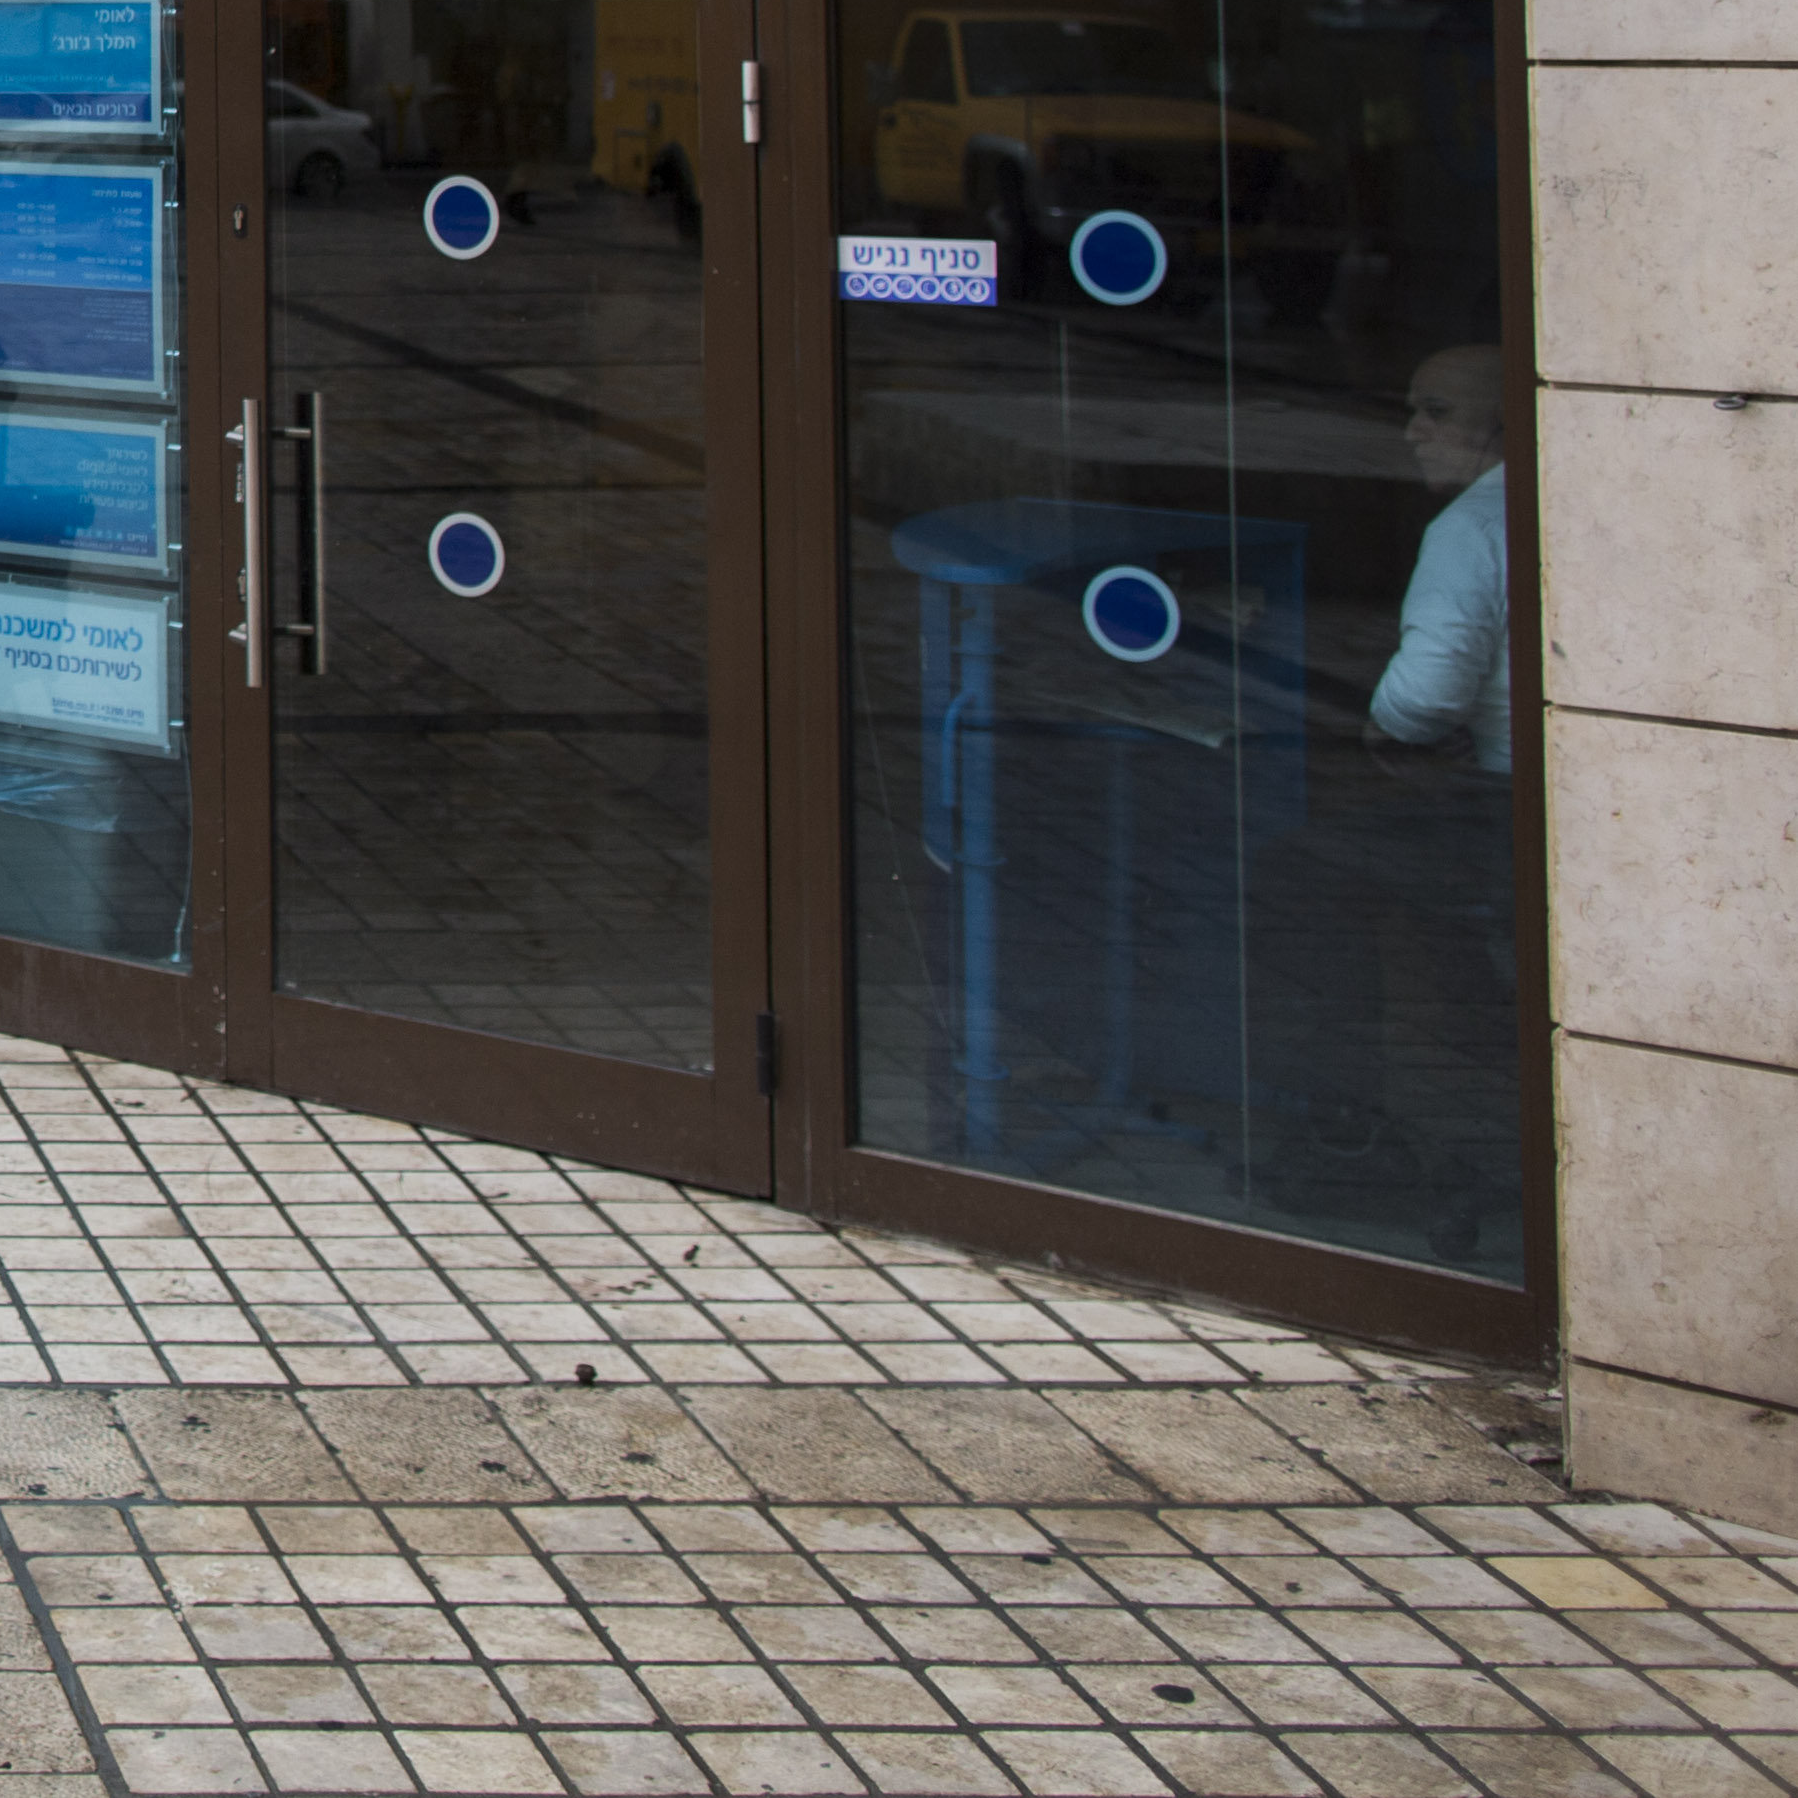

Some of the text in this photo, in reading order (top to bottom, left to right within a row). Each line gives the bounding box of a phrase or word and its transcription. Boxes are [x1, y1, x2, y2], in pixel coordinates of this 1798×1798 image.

[95, 6, 135, 23] לאומי
[96, 33, 135, 52] המלך
[53, 104, 137, 117] ברוכים הבאים
[853, 245, 981, 274] סניף נגיש
[82, 624, 143, 652] לאומי
[4, 647, 53, 670] בסניף
[56, 653, 142, 682] לשירותכם
